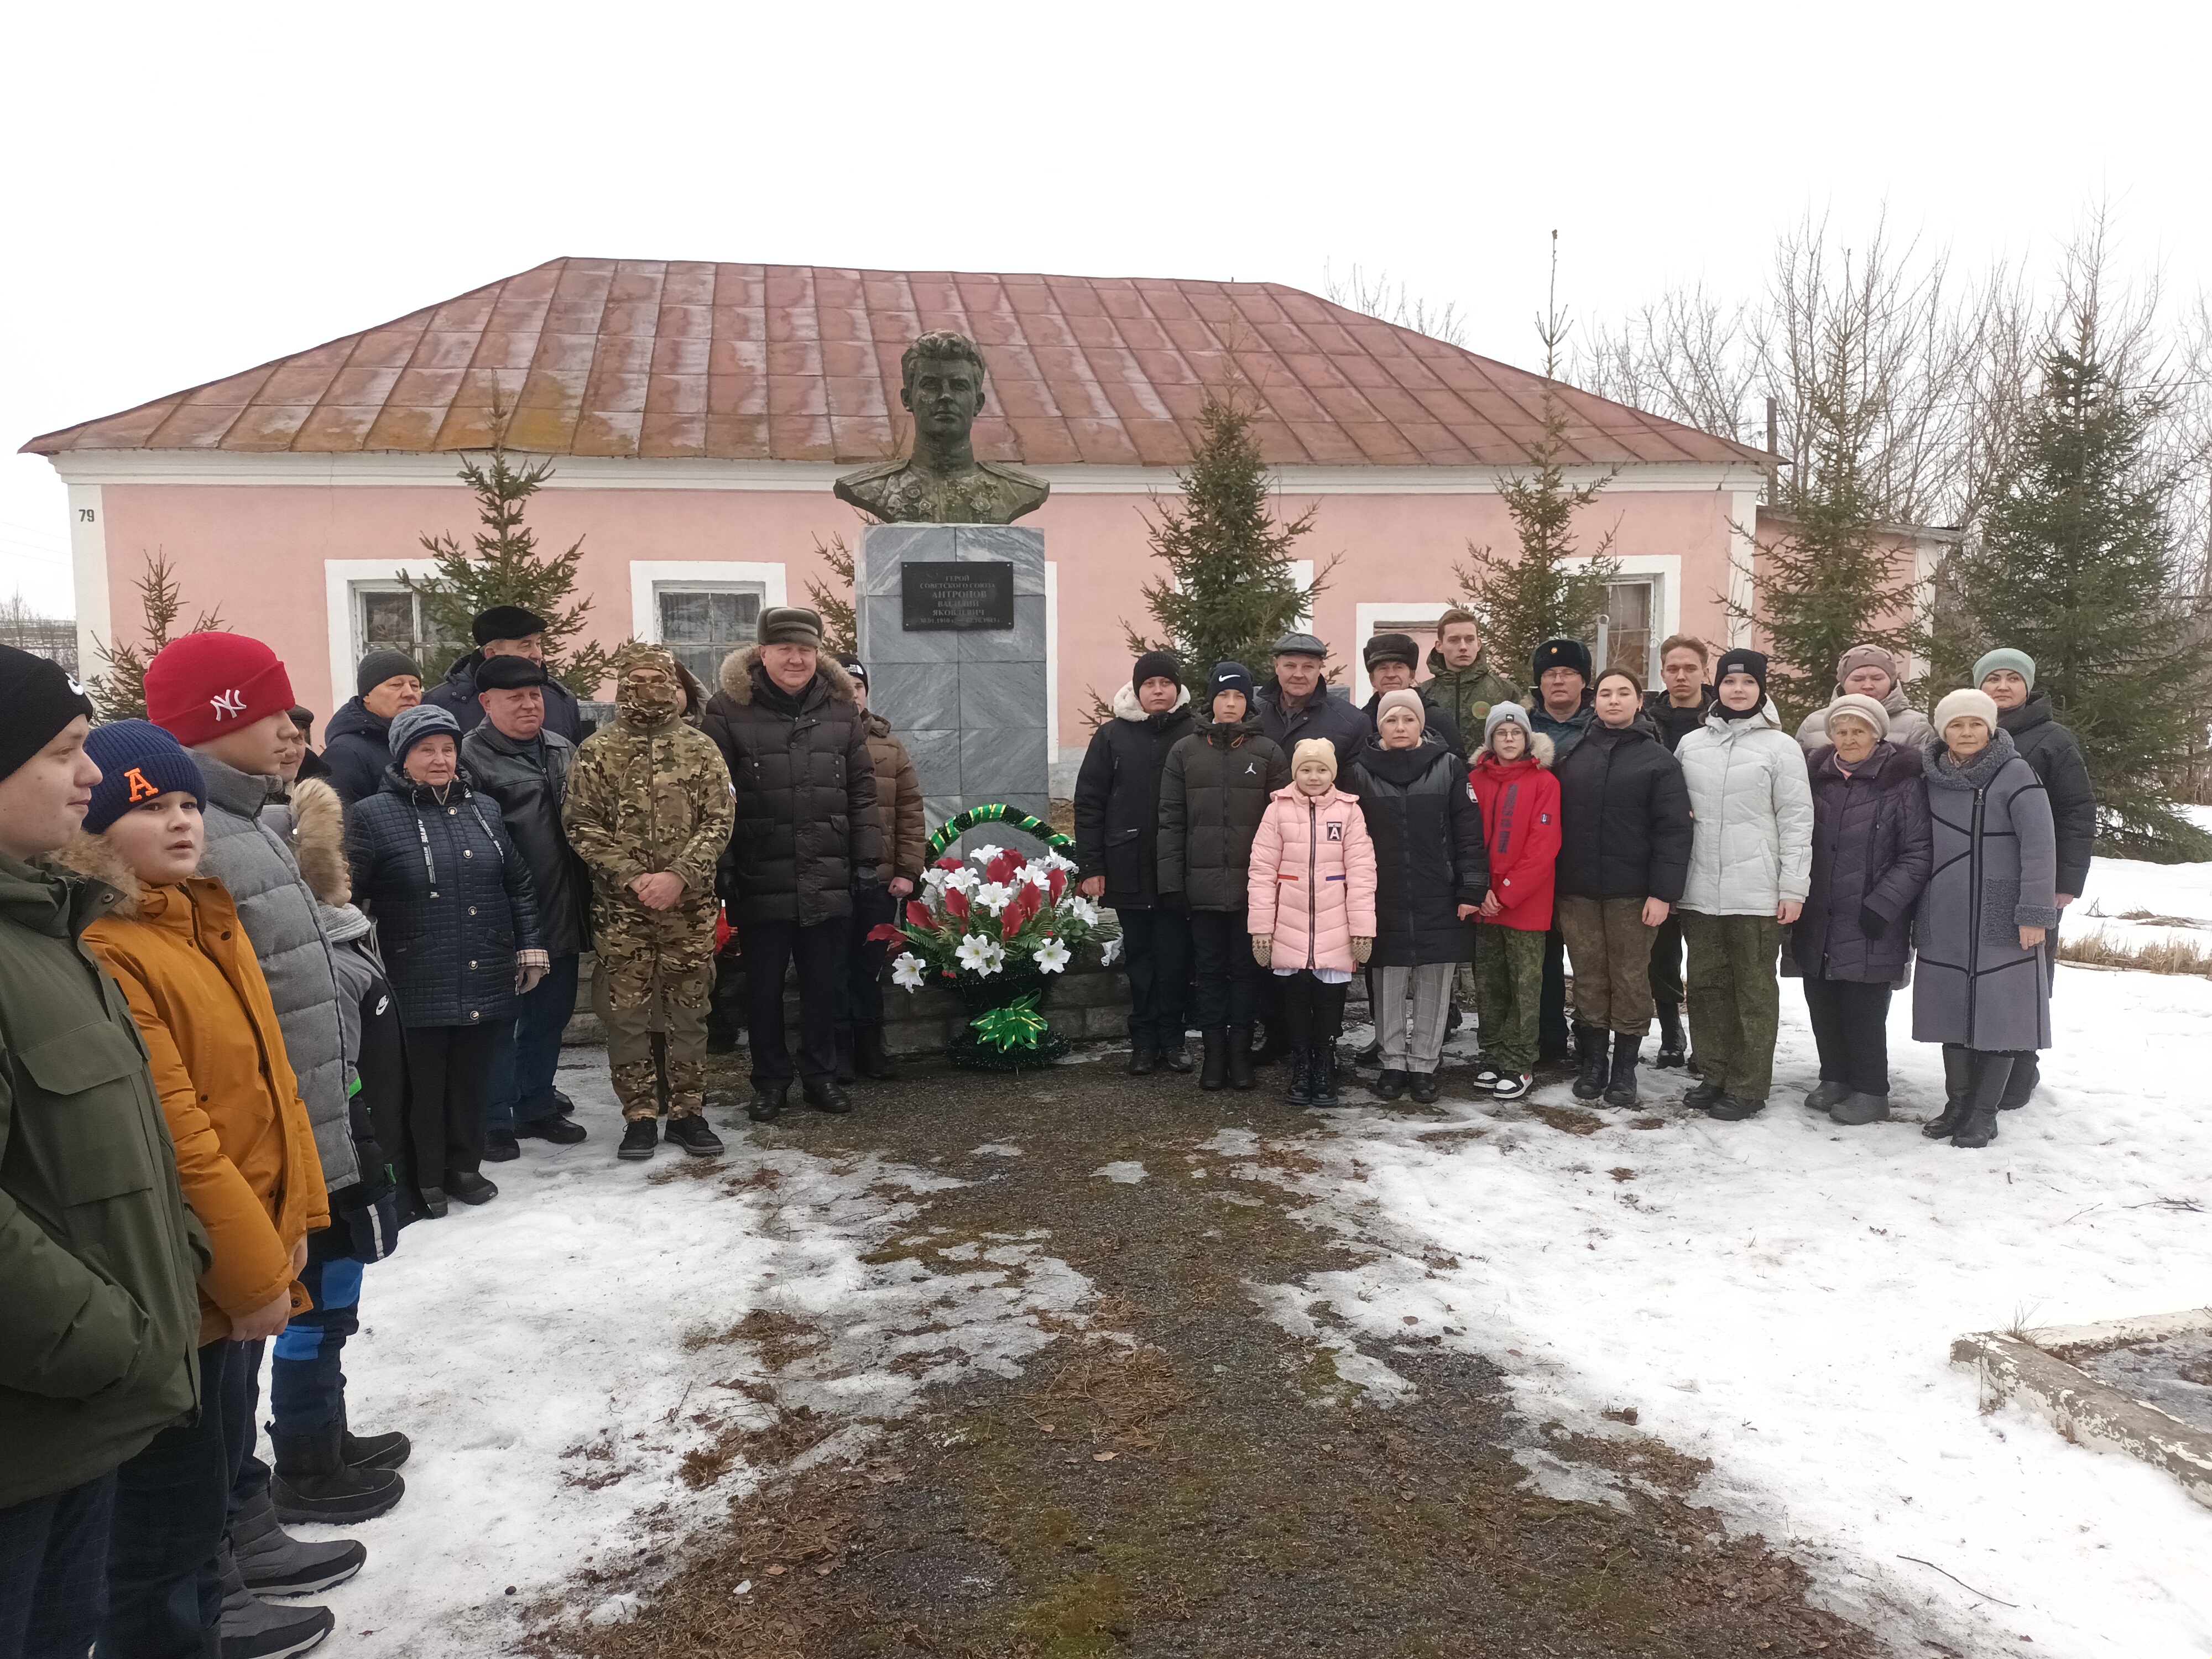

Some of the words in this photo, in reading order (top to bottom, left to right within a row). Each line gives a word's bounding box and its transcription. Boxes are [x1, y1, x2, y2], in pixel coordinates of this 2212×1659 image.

[79, 509, 95, 522] 79
[210, 689, 247, 722] NY
[124, 768, 159, 802] A
[1329, 827, 1340, 839] A
